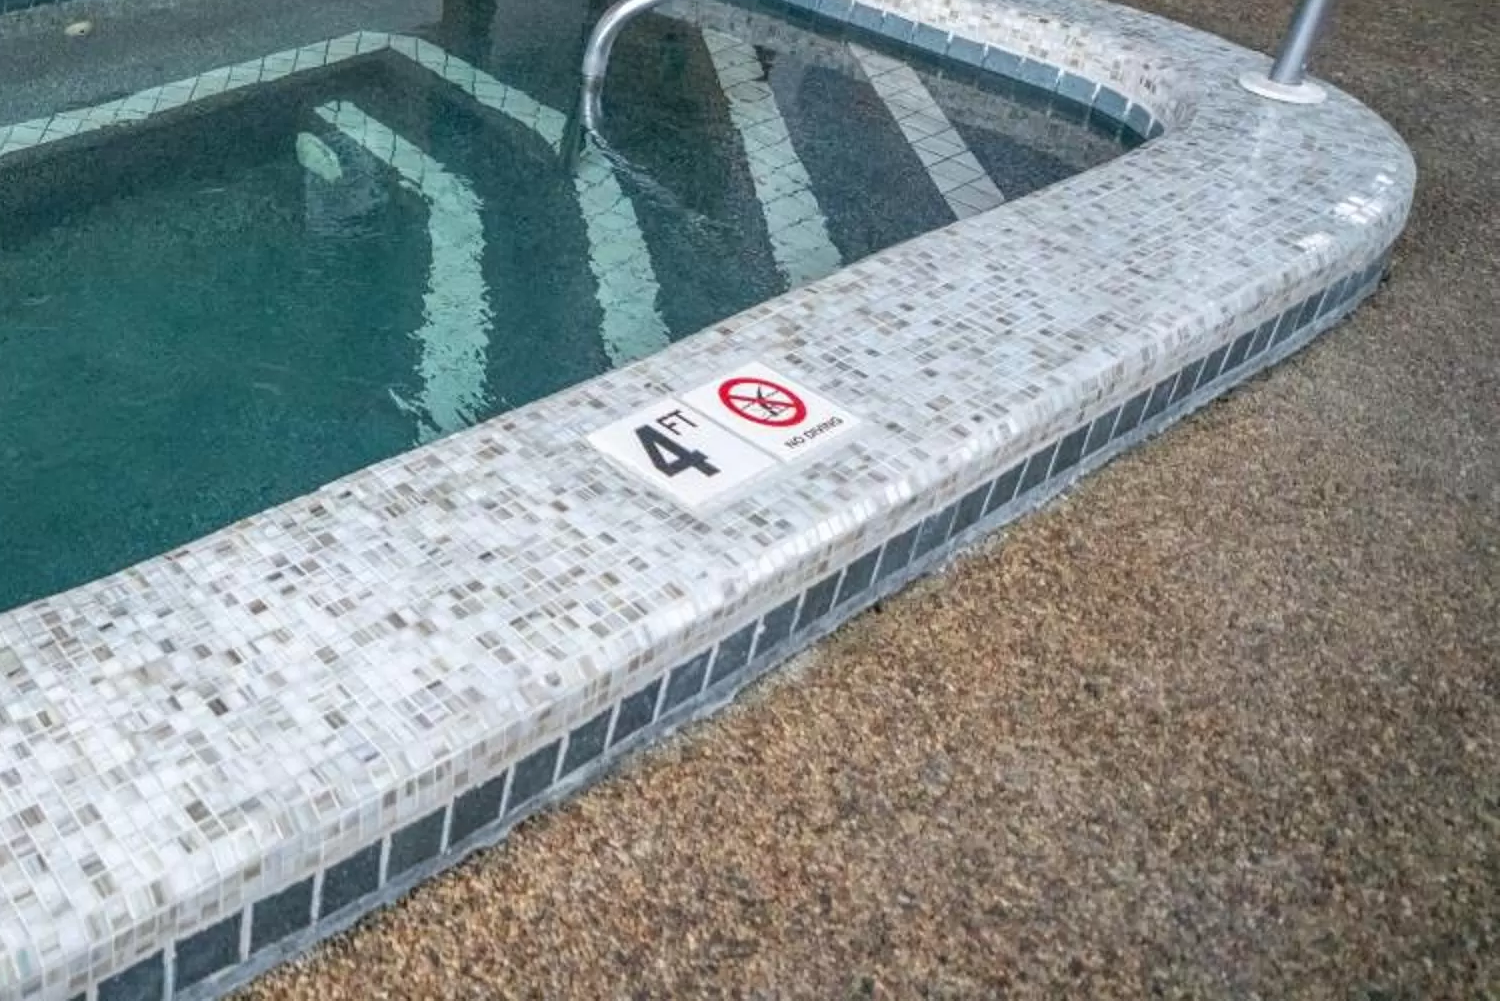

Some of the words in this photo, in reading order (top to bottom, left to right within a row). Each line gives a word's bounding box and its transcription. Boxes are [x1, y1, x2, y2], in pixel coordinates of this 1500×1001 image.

[656, 409, 699, 436] FT
[784, 435, 806, 450] NO
[803, 415, 845, 440] DIVING
[634, 424, 723, 478] 4
